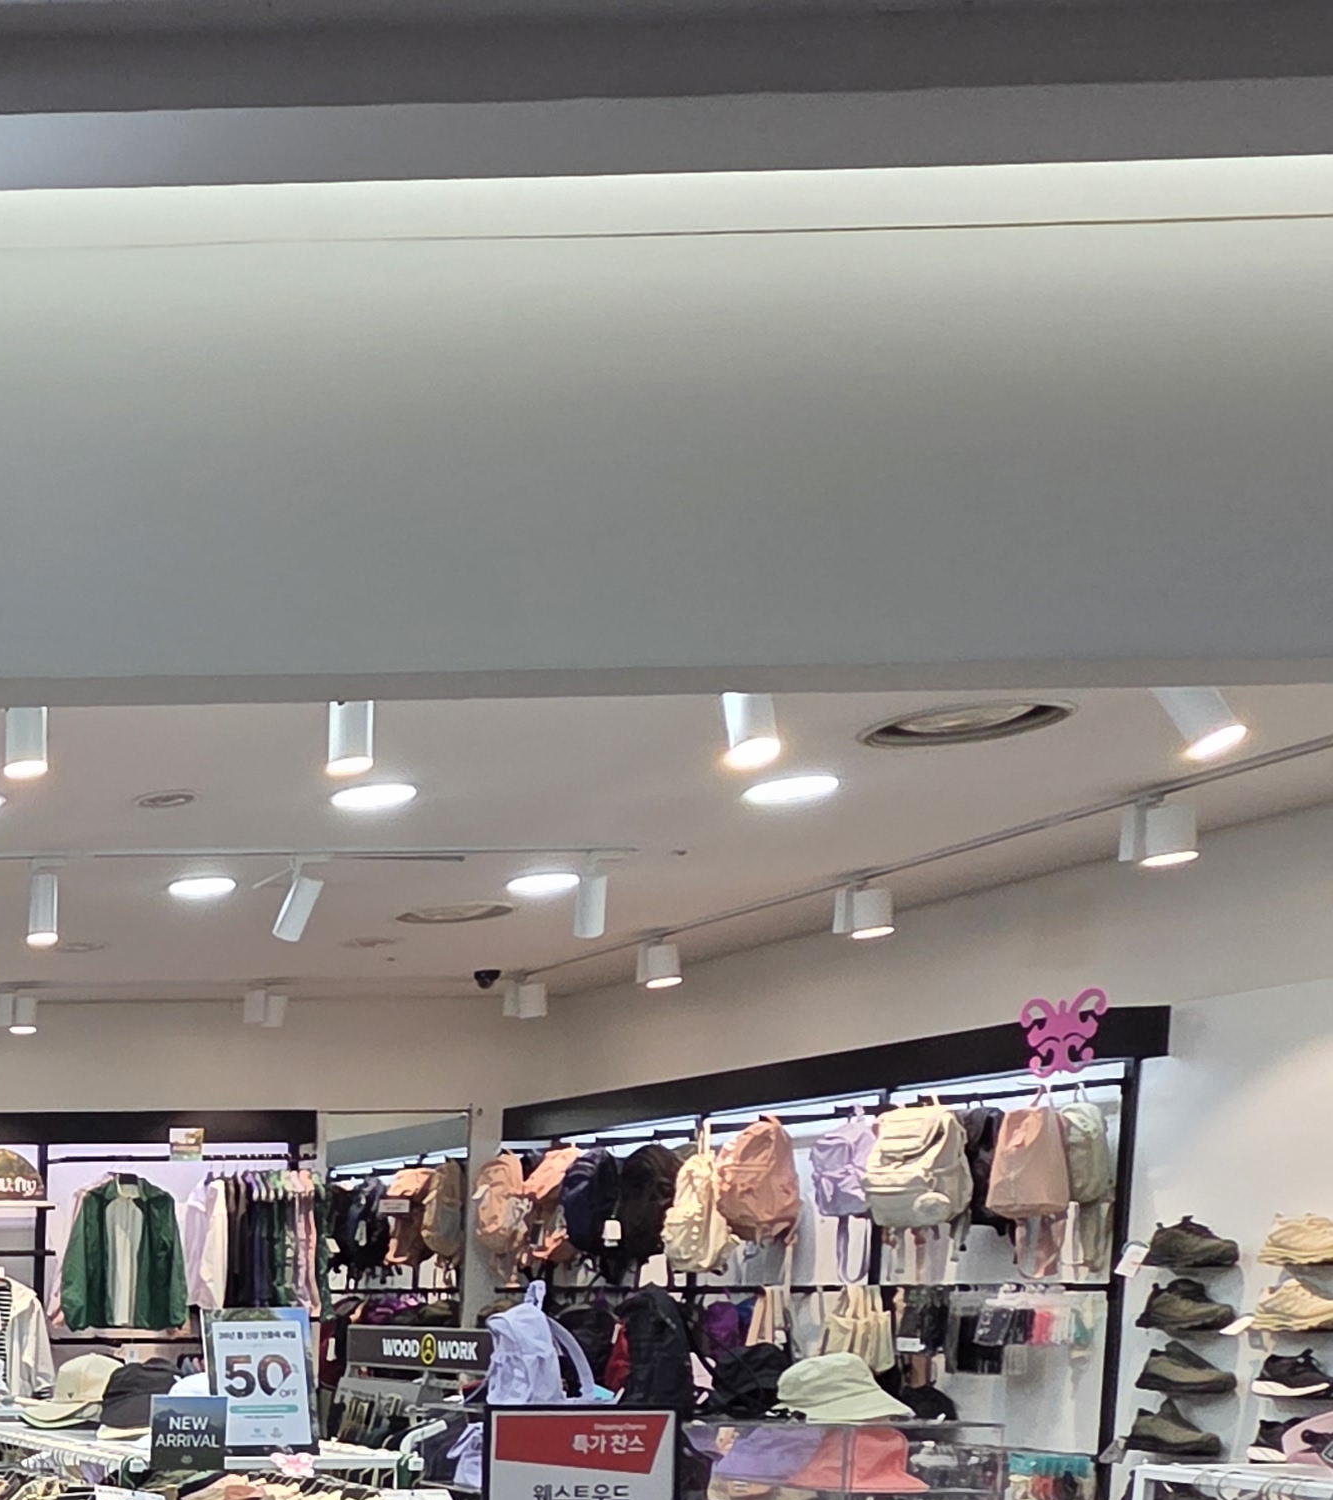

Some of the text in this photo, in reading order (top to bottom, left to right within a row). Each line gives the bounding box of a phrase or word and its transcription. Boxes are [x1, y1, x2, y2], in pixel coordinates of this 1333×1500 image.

[381, 1338, 479, 1361] WOOD WORK
[169, 1415, 209, 1431] NEW
[155, 1433, 220, 1449] ARRIVAL
